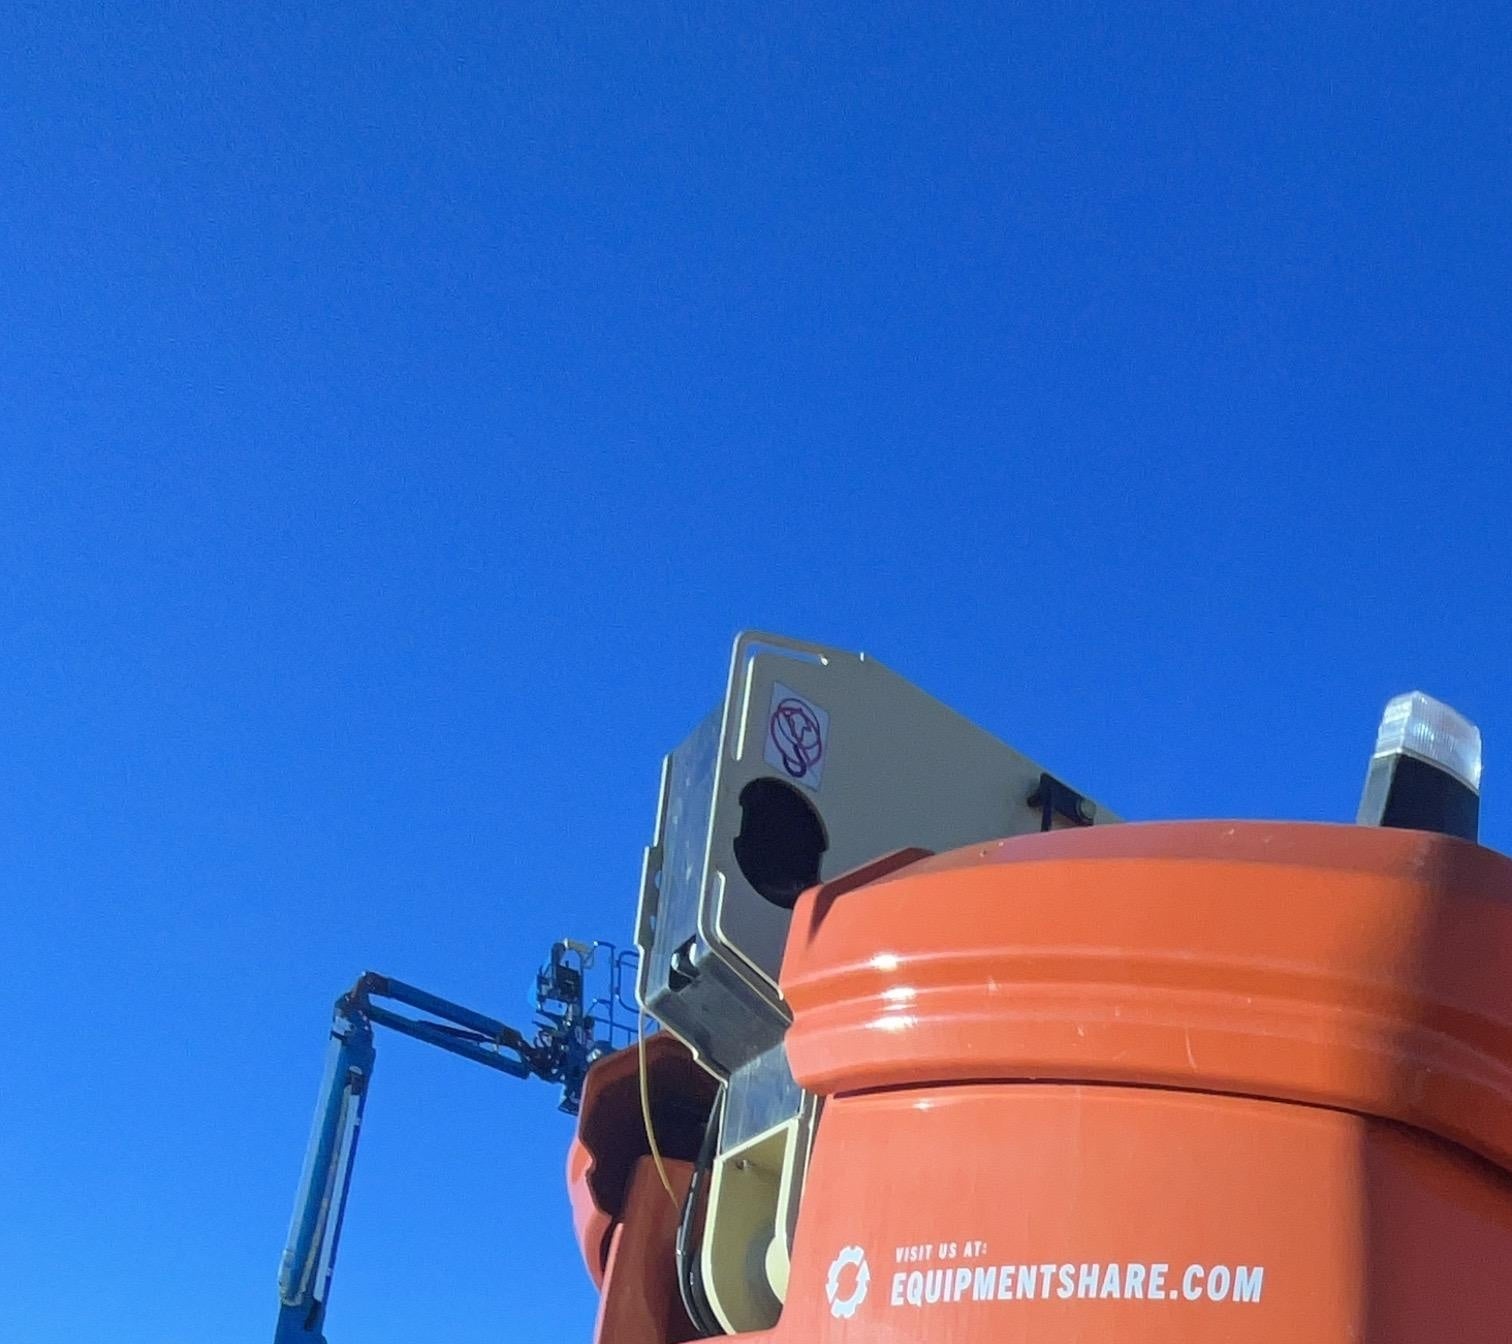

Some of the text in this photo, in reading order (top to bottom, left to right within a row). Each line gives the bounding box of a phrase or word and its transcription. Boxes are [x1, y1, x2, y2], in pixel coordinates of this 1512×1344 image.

[895, 1240, 988, 1263] VISIT US AT:
[889, 1263, 1265, 1307] EQUIPMENTSHARE.COM
